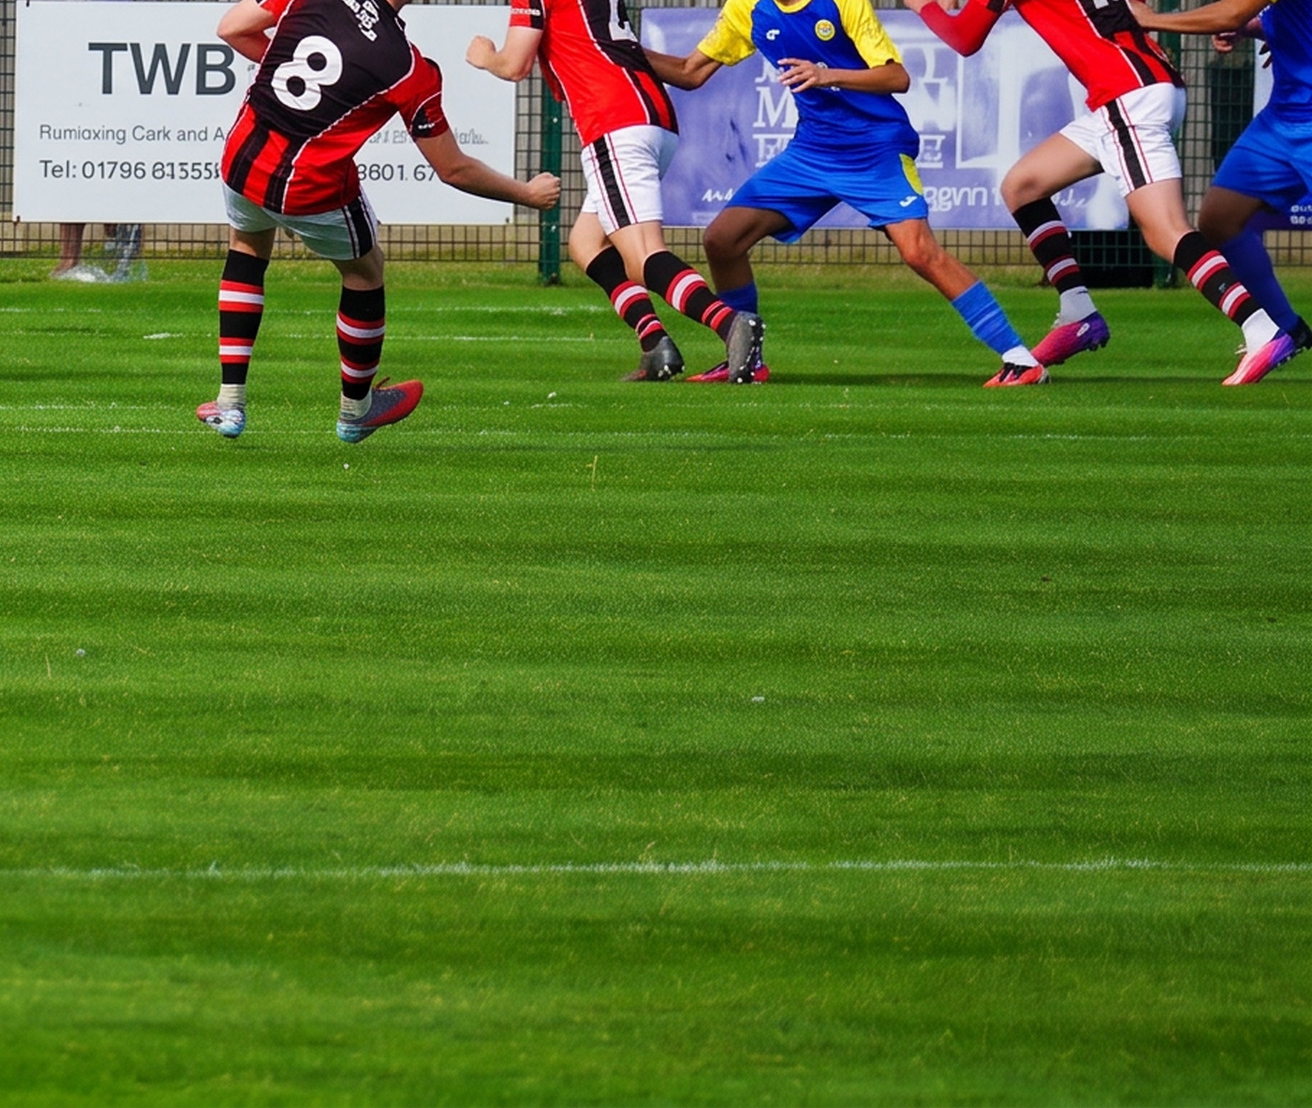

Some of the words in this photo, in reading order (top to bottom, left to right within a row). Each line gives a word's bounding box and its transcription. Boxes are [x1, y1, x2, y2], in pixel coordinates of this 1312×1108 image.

[88, 42, 237, 96] TWB
[271, 35, 344, 111] 8
[177, 126, 208, 142] and
[39, 159, 77, 179] Tel:
